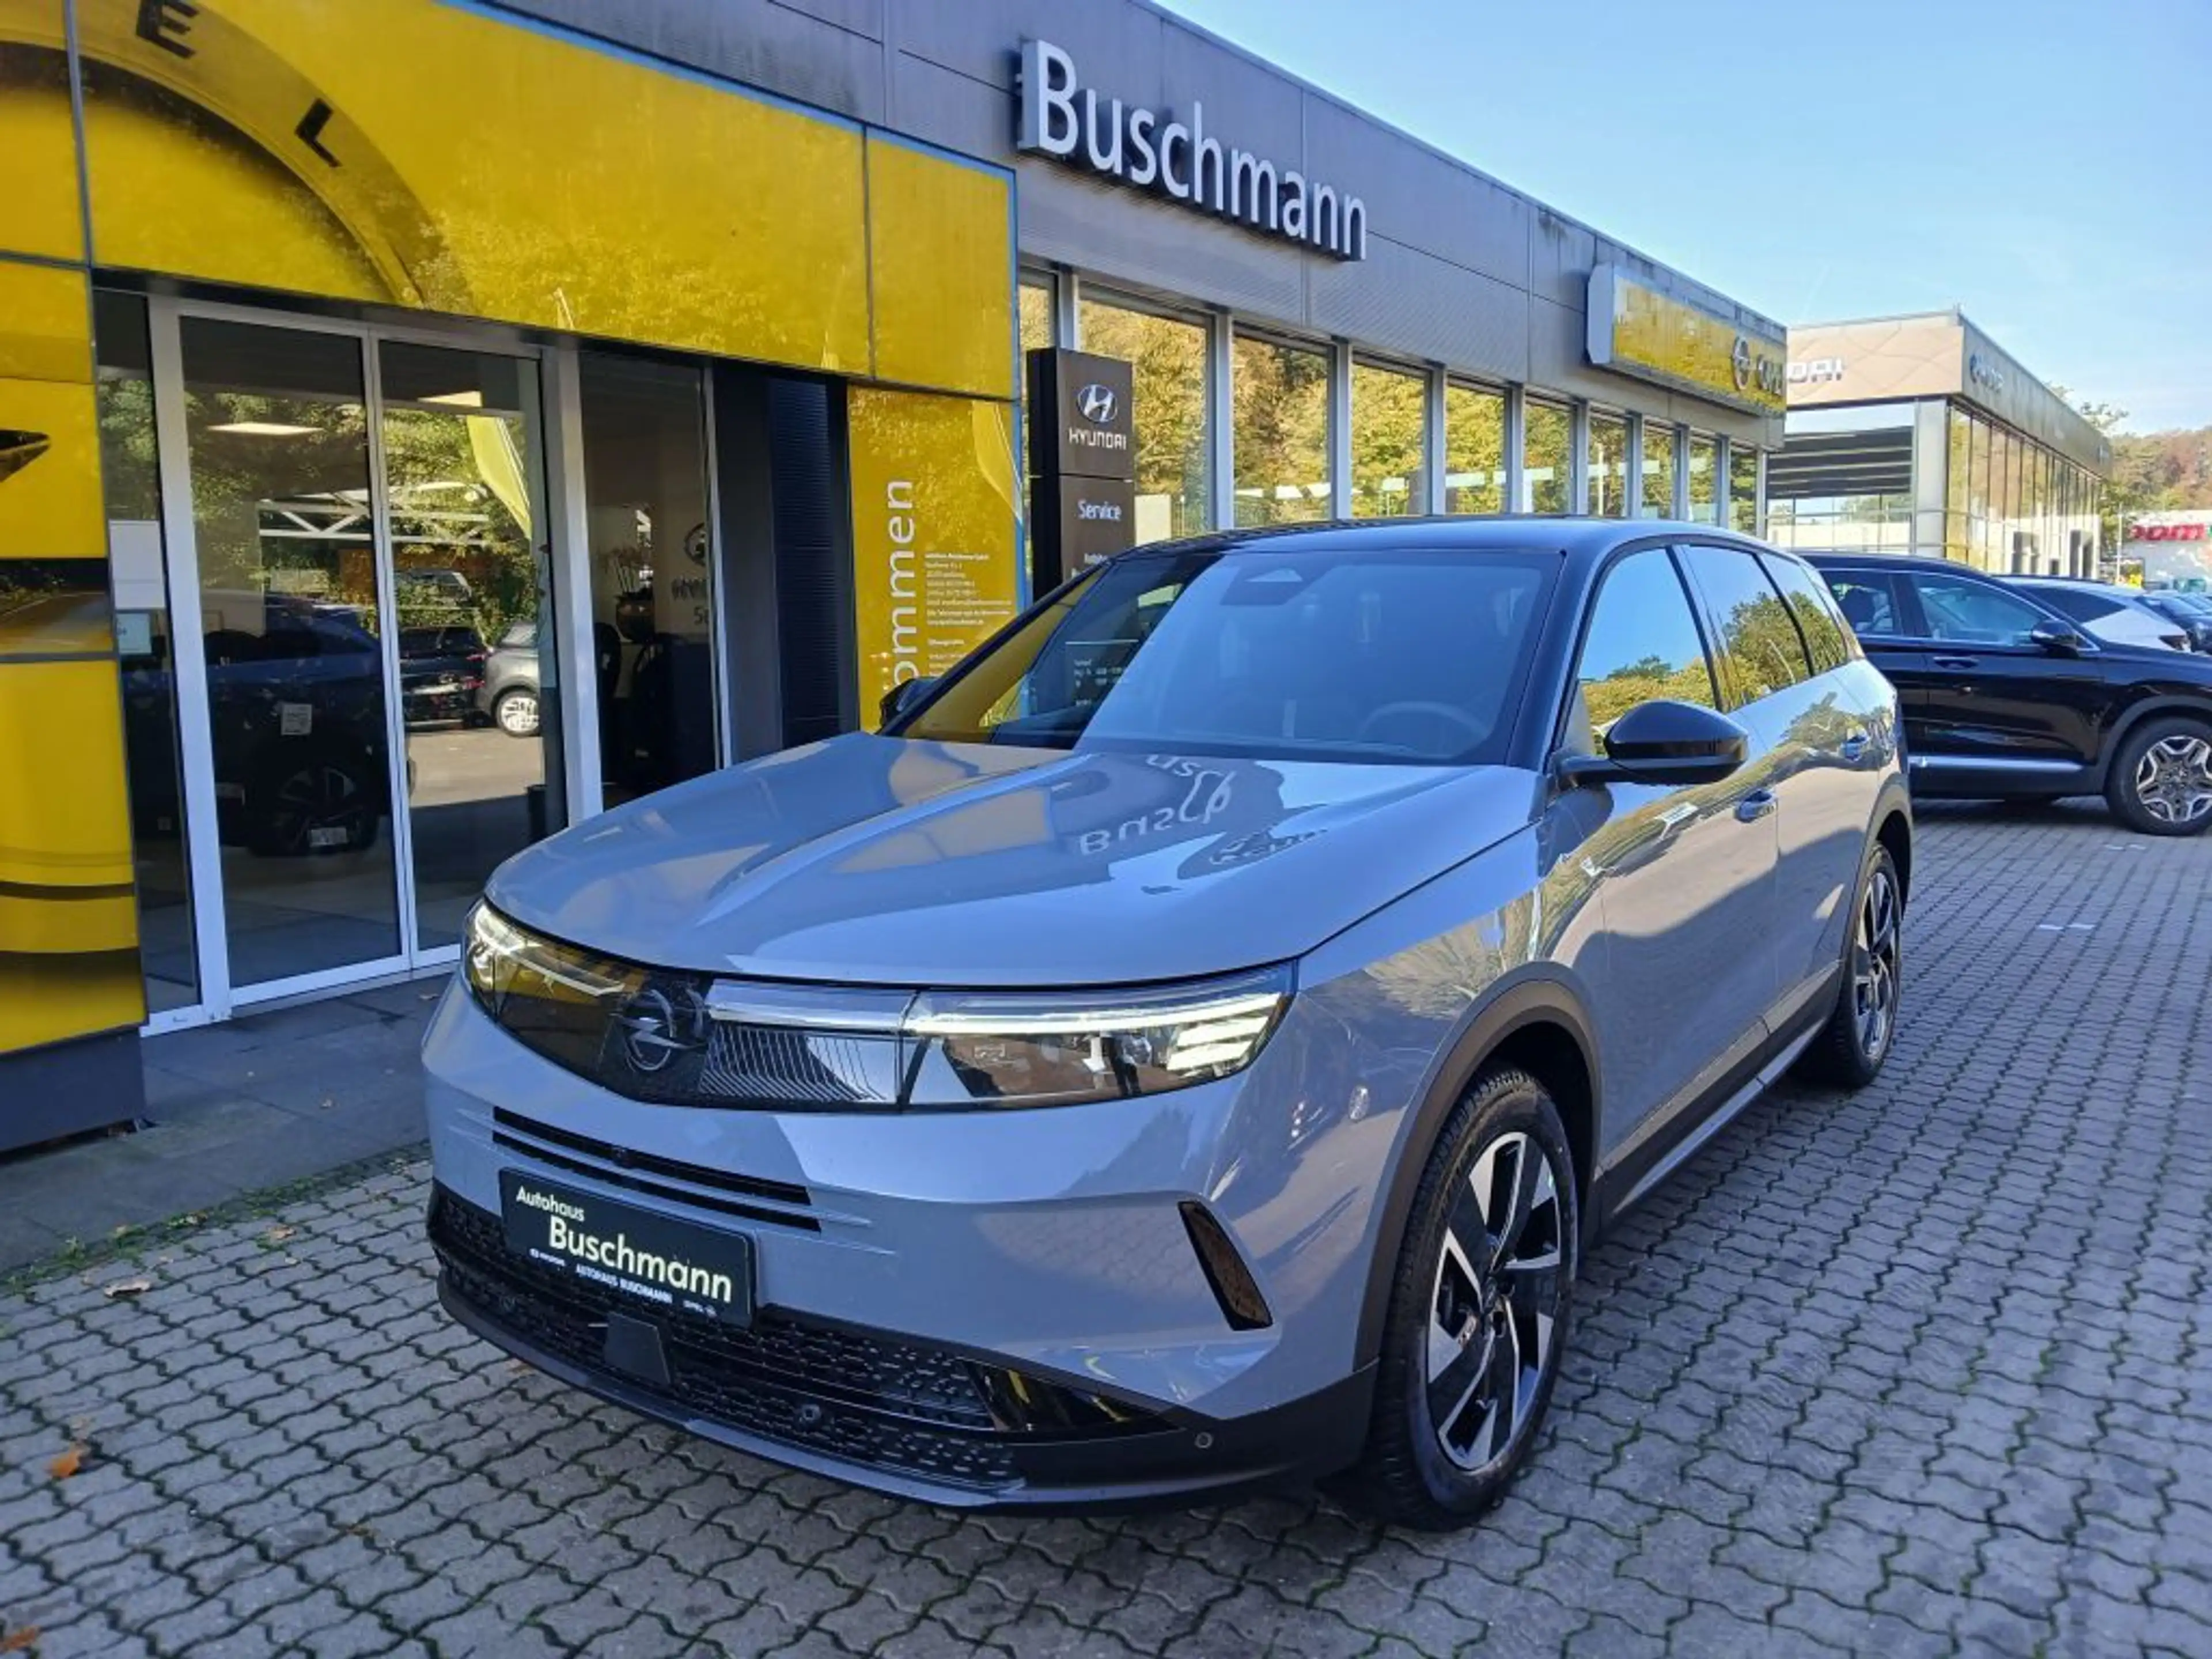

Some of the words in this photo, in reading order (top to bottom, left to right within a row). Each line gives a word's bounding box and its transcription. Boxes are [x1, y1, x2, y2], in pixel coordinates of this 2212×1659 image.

[1021, 40, 1367, 261] Buschmann
[1069, 427, 1127, 450] HYUNDAI
[1078, 499, 1122, 520] Service
[516, 1185, 585, 1222] Autohaus
[549, 1215, 732, 1303] Buschmann
